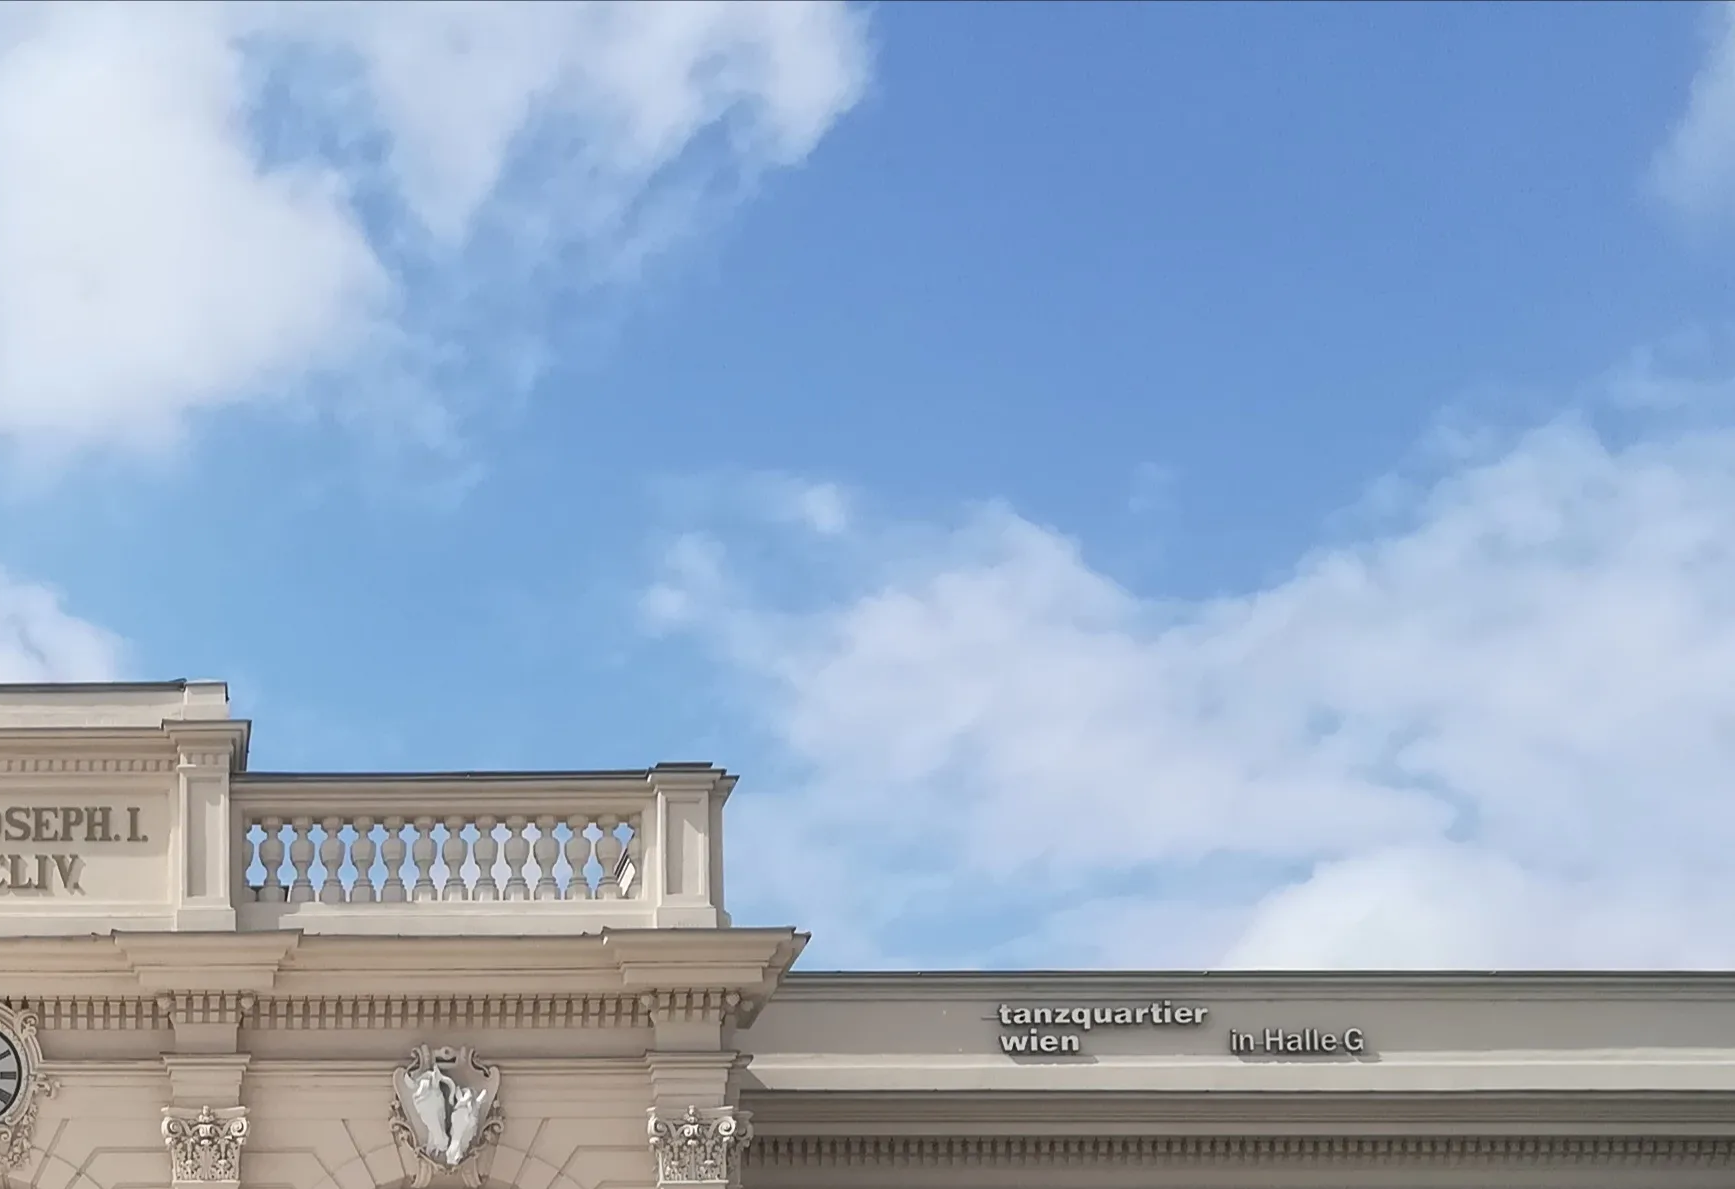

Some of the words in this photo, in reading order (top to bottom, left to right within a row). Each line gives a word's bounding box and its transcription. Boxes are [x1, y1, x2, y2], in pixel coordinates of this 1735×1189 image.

[999, 1000, 1208, 1029] tanzquartier
[1000, 1028, 1079, 1051] wien
[1230, 1029, 1254, 1051] in
[1264, 1028, 1337, 1051] Halle
[1344, 1028, 1364, 1051] G
